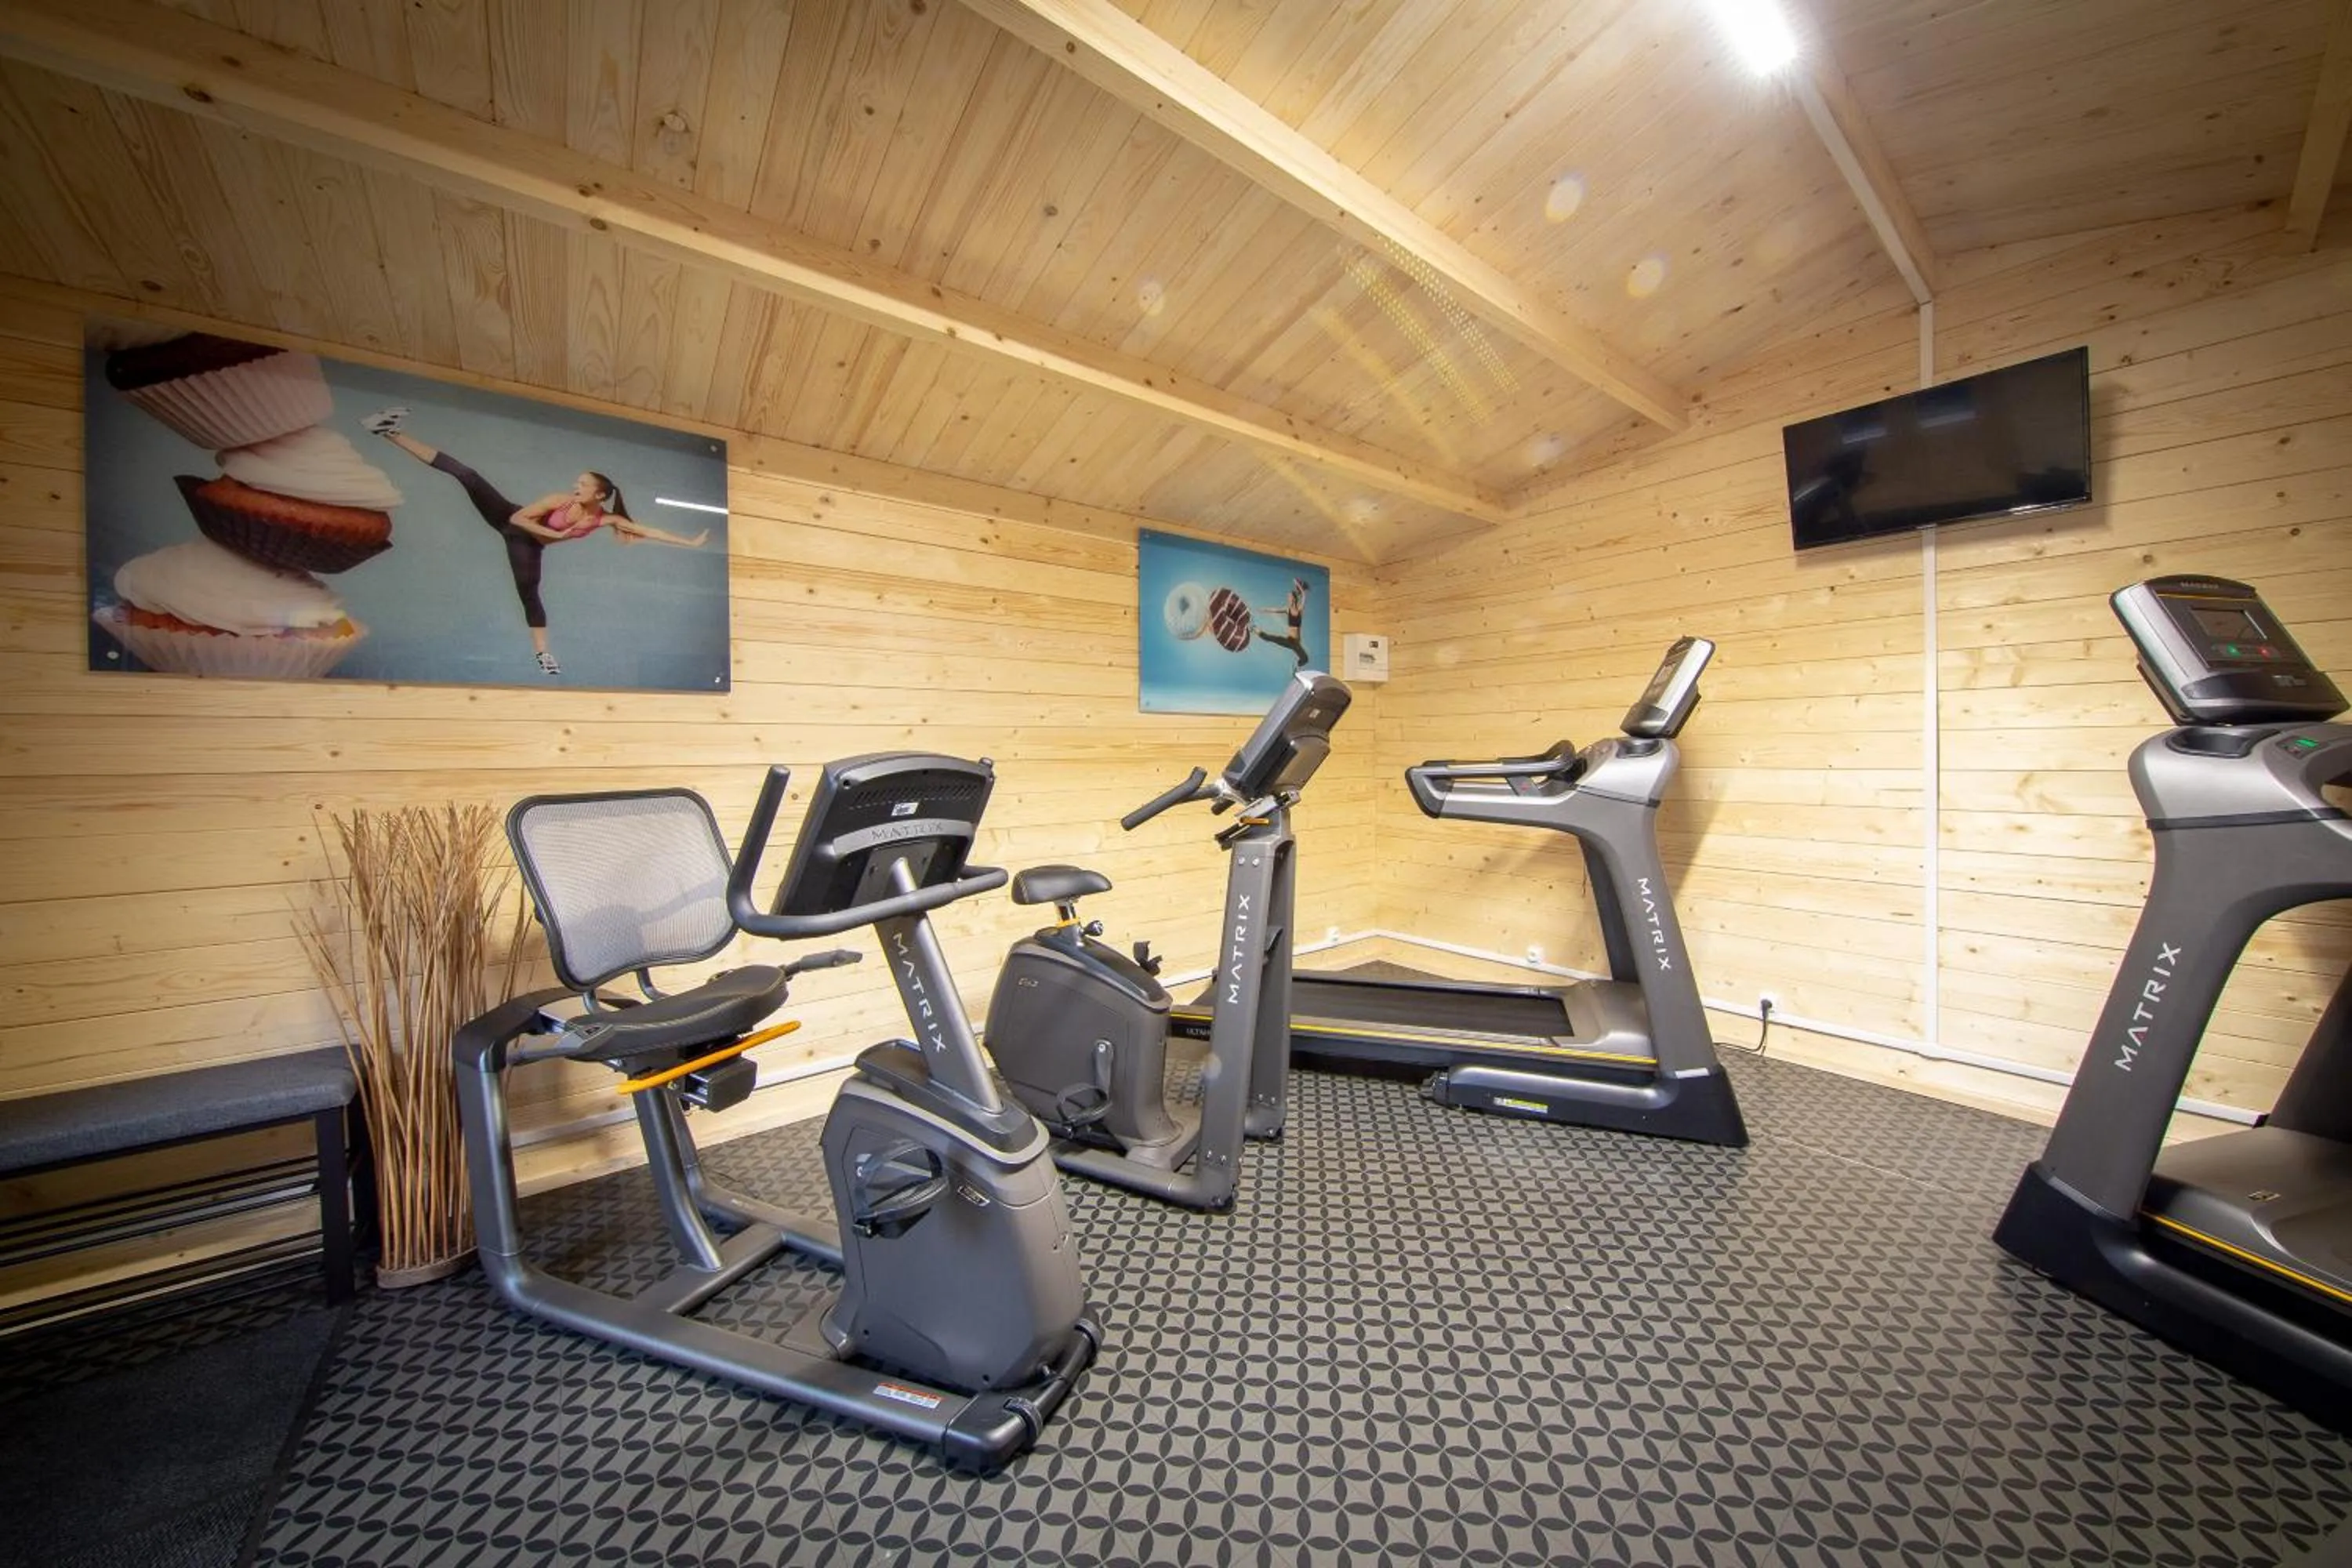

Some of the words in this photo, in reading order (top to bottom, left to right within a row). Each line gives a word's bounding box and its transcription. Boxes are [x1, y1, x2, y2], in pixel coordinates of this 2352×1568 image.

[1227, 895, 1250, 1004] MATRIX
[1638, 878, 1671, 971] MATRIX
[893, 932, 946, 1053] MATRIX
[2116, 942, 2182, 1073] MATRIX
